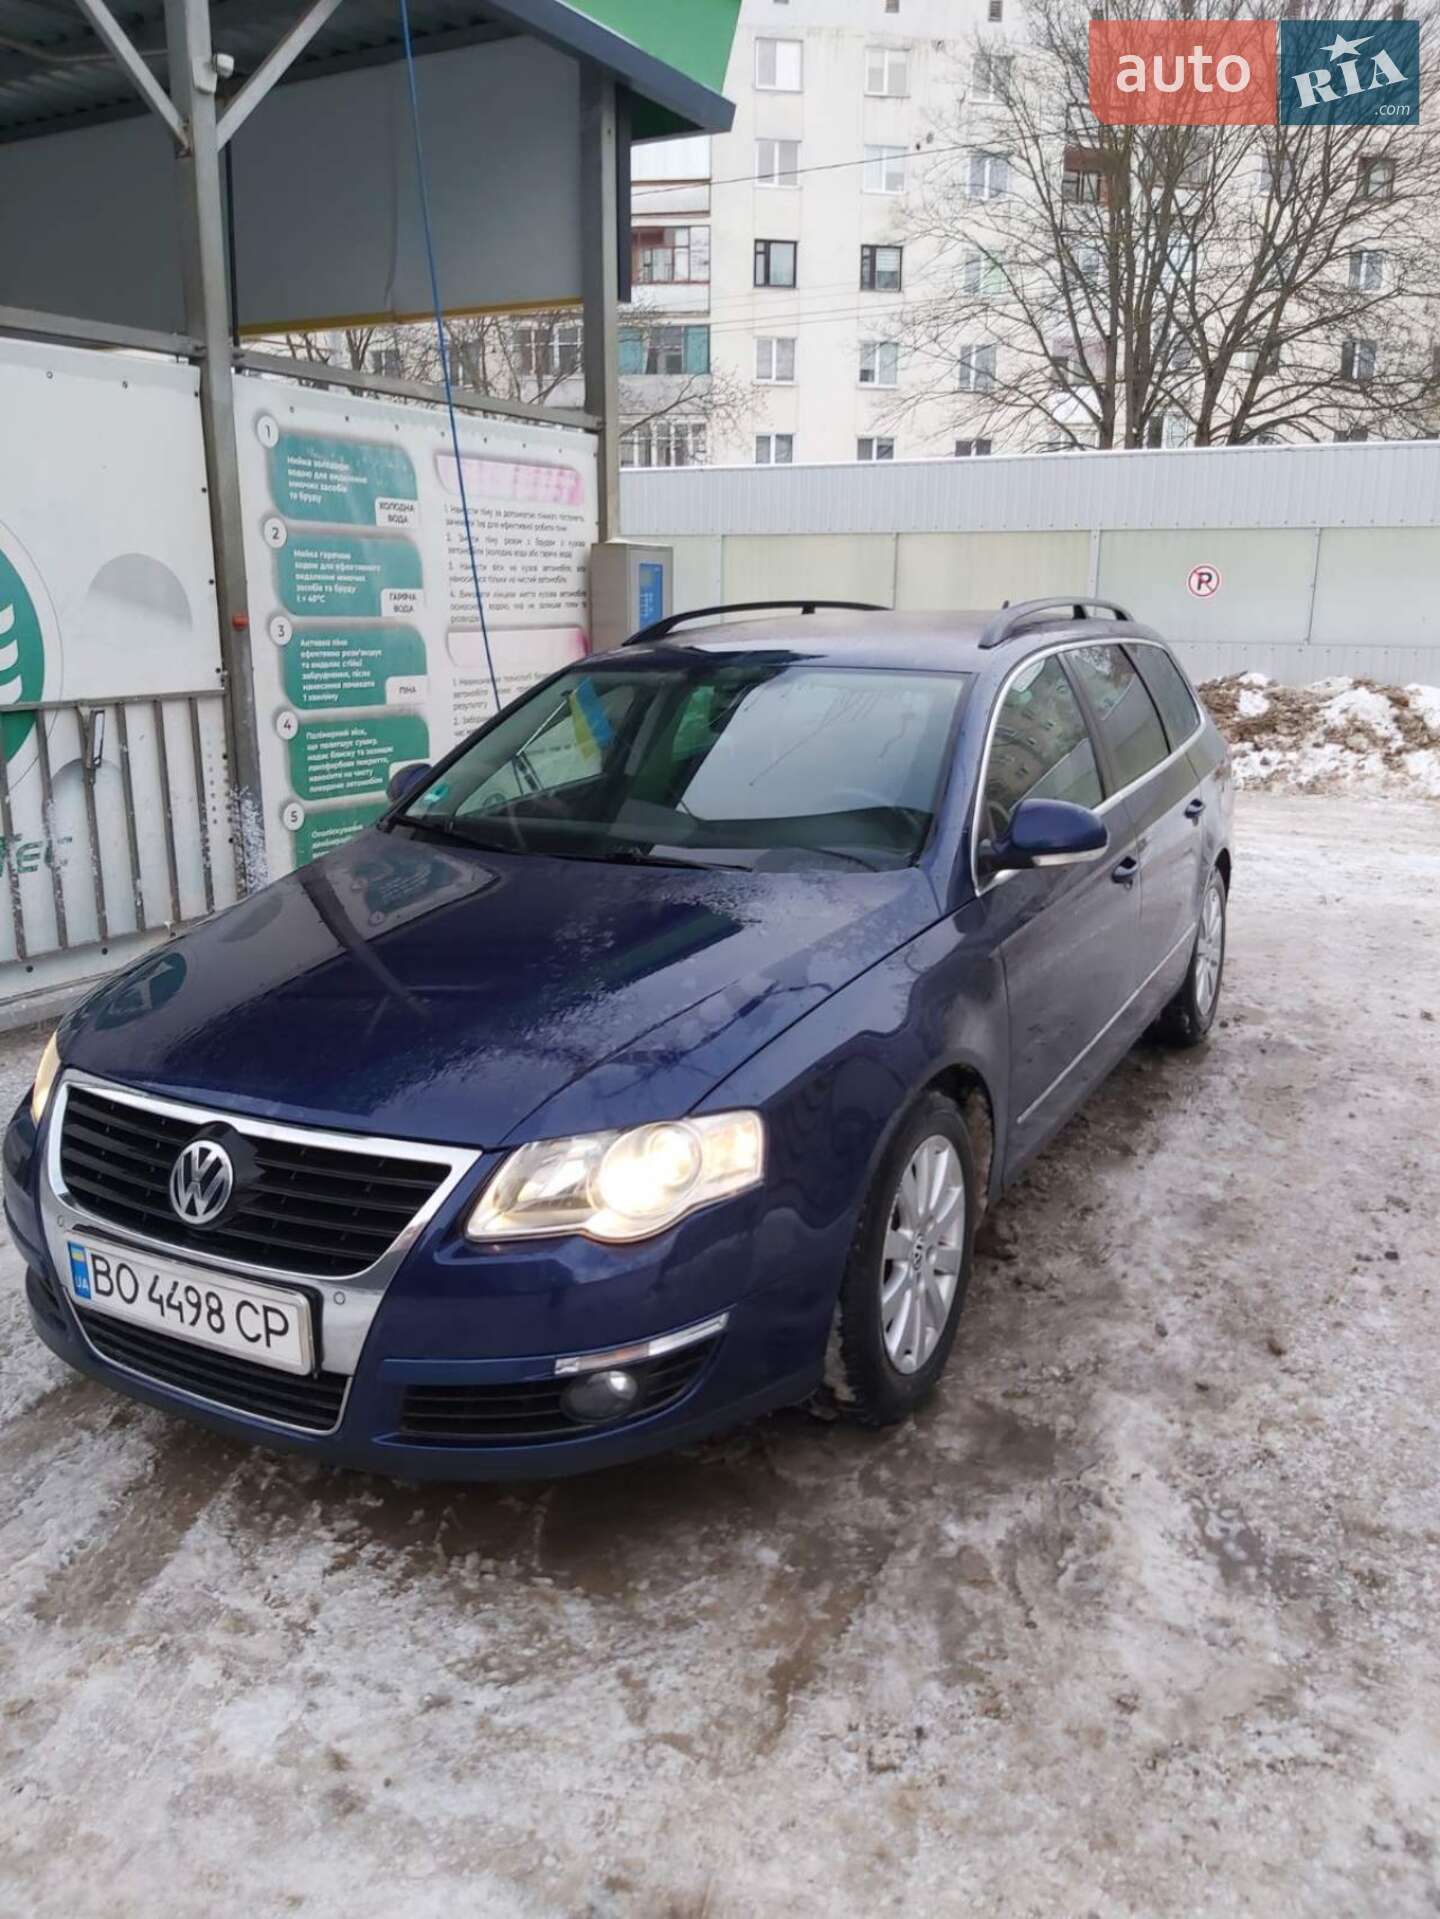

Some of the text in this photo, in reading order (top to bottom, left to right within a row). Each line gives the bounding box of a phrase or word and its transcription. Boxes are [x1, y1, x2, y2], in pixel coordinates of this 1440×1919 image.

[272, 527, 280, 540] 2
[277, 624, 285, 638] 3
[283, 719, 292, 731] 4
[290, 810, 298, 823] 5
[91, 1255, 290, 1348] BO 4498 CP
